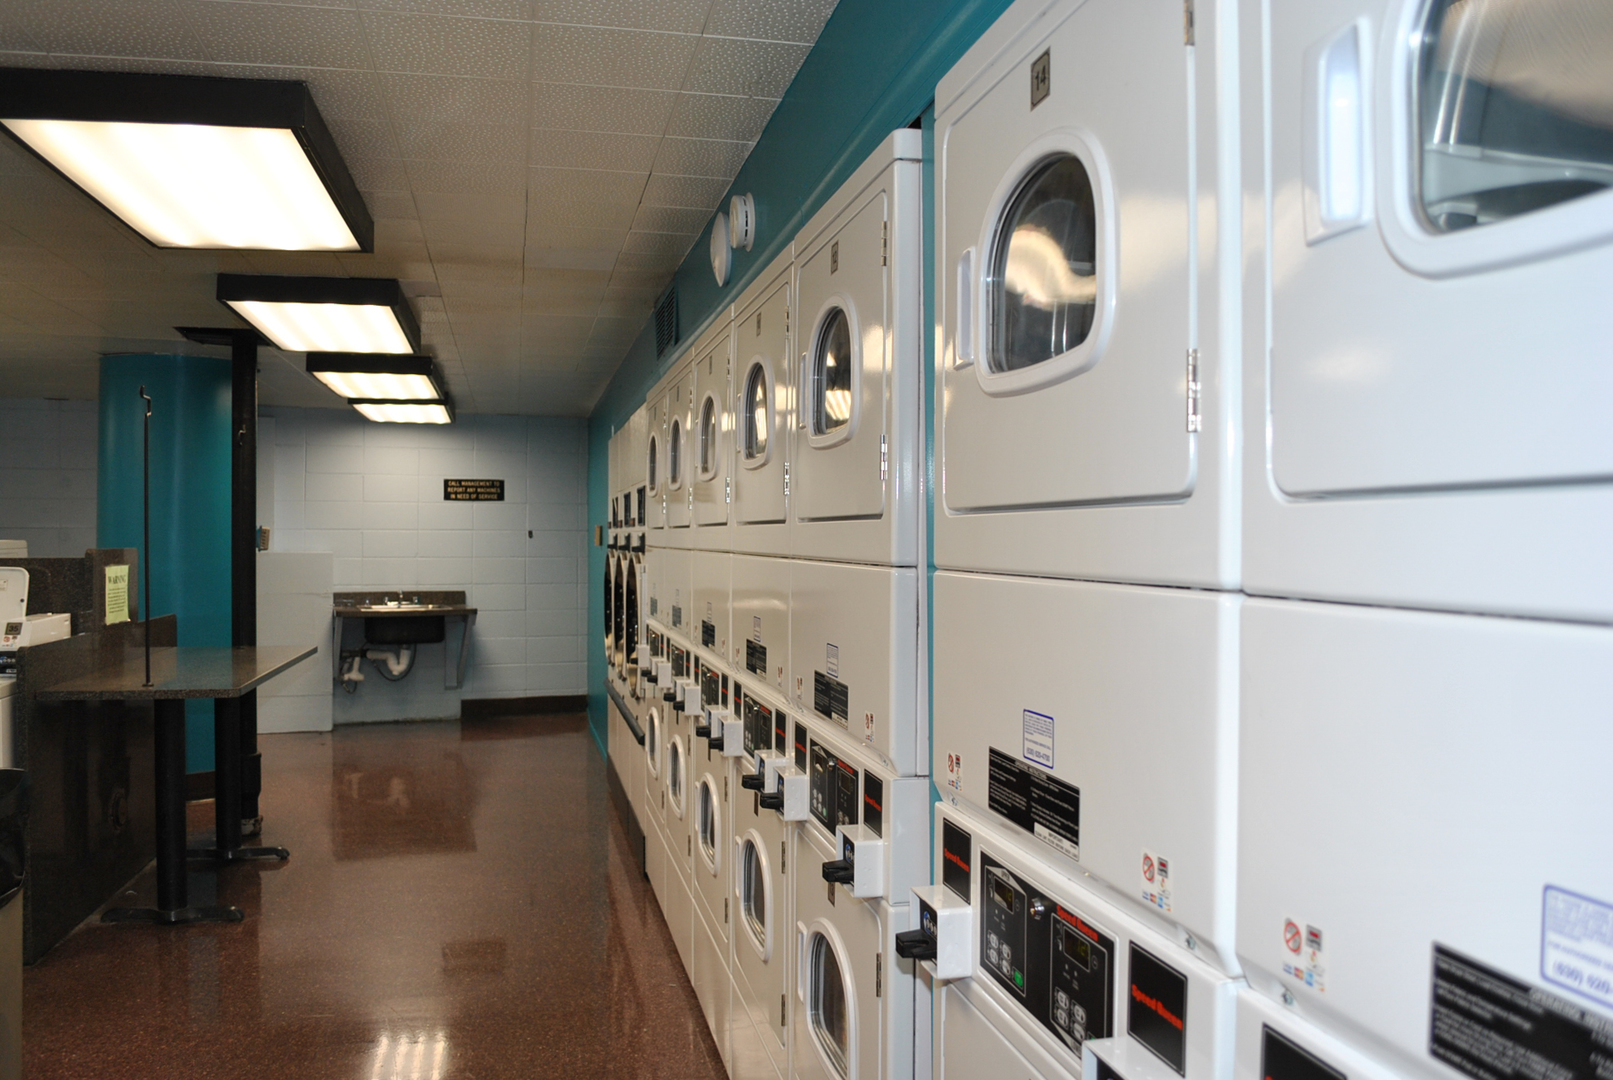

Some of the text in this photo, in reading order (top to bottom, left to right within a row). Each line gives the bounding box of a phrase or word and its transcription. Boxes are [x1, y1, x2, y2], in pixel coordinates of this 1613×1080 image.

[1035, 65, 1047, 91] 14
[108, 574, 127, 584] WARNING
[1132, 983, 1184, 1031] Speed Queen
